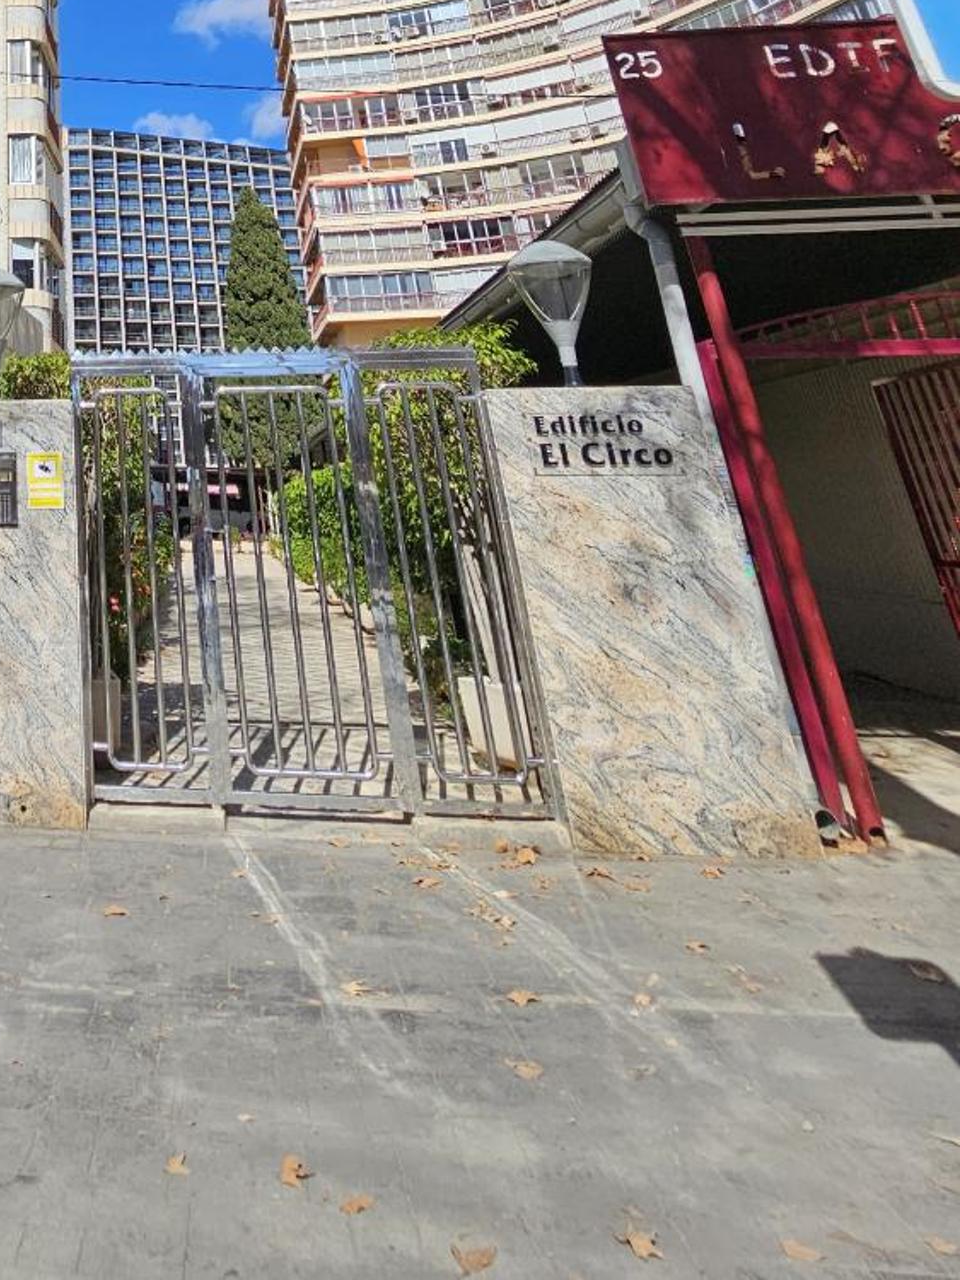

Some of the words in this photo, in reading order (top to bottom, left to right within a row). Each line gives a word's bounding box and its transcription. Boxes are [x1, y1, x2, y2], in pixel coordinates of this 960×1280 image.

[615, 51, 663, 80] 25
[533, 415, 643, 435] Edificio
[540, 442, 570, 467] El
[581, 442, 673, 468] Circo
